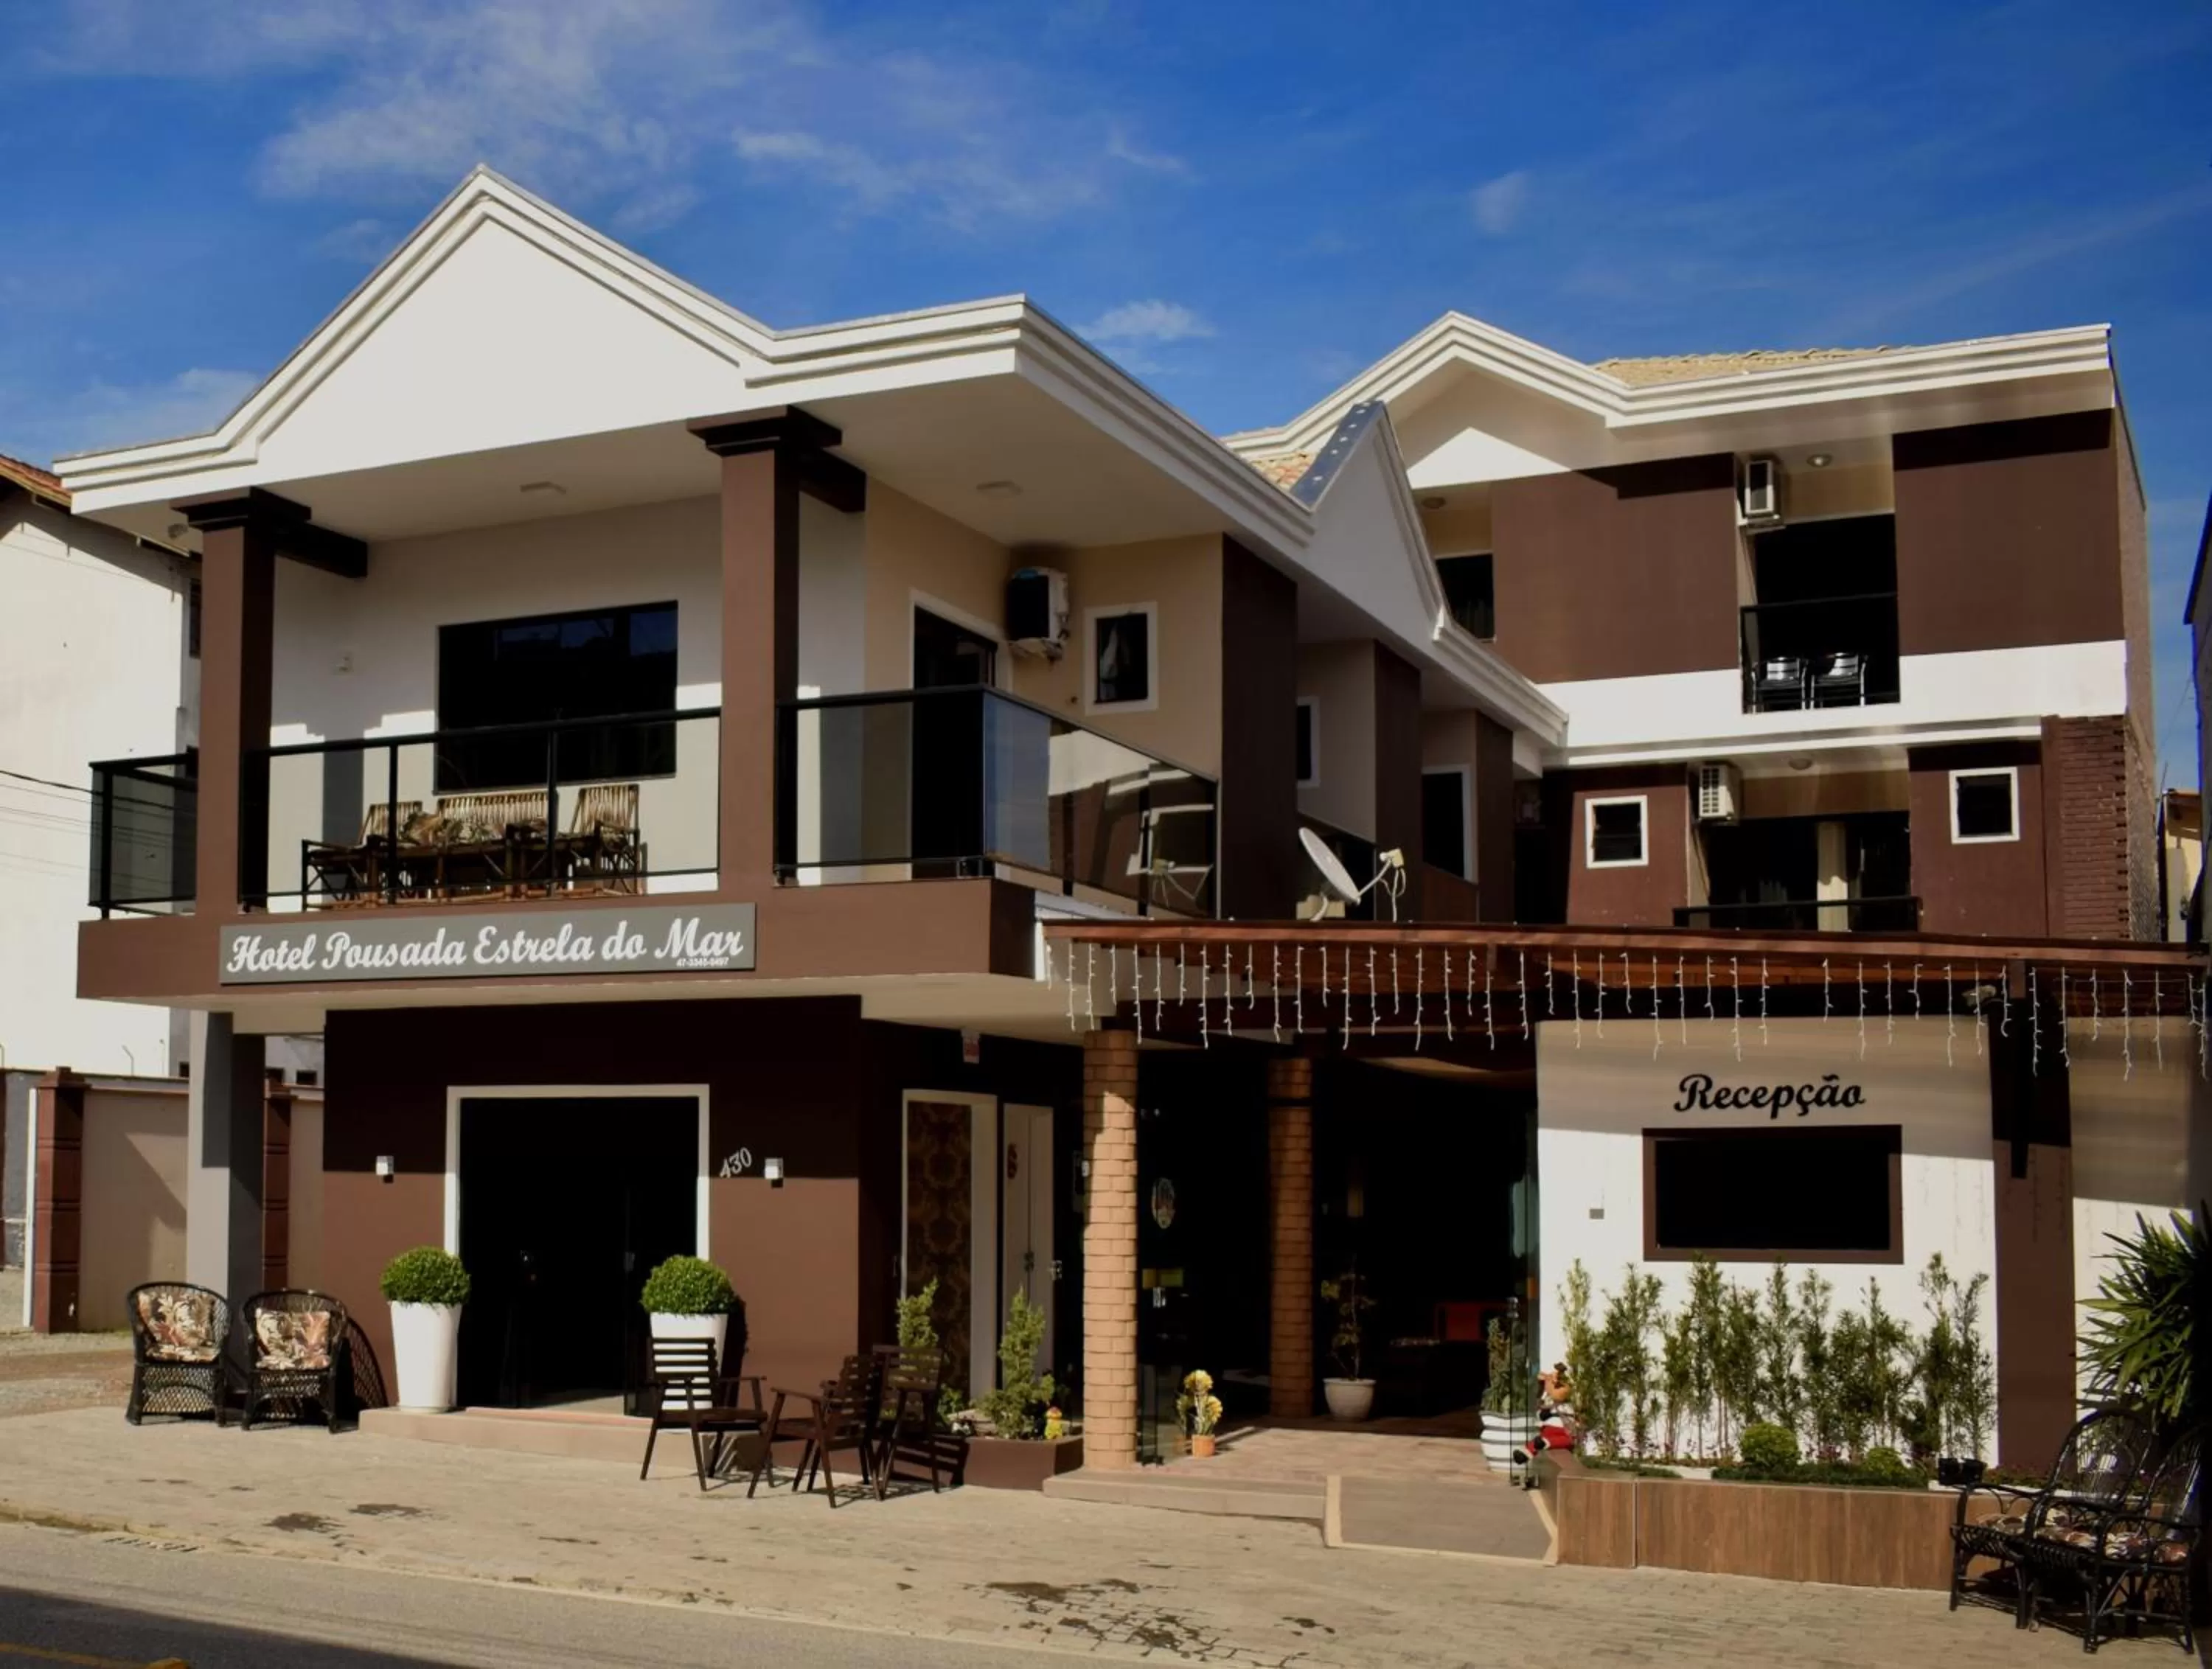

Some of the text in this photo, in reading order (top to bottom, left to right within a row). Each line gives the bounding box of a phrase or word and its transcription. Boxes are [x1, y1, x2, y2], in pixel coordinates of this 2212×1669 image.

[226, 917, 744, 972] Hotel Pousada Estrela do Mar
[1673, 1073, 1866, 1120] Recepção
